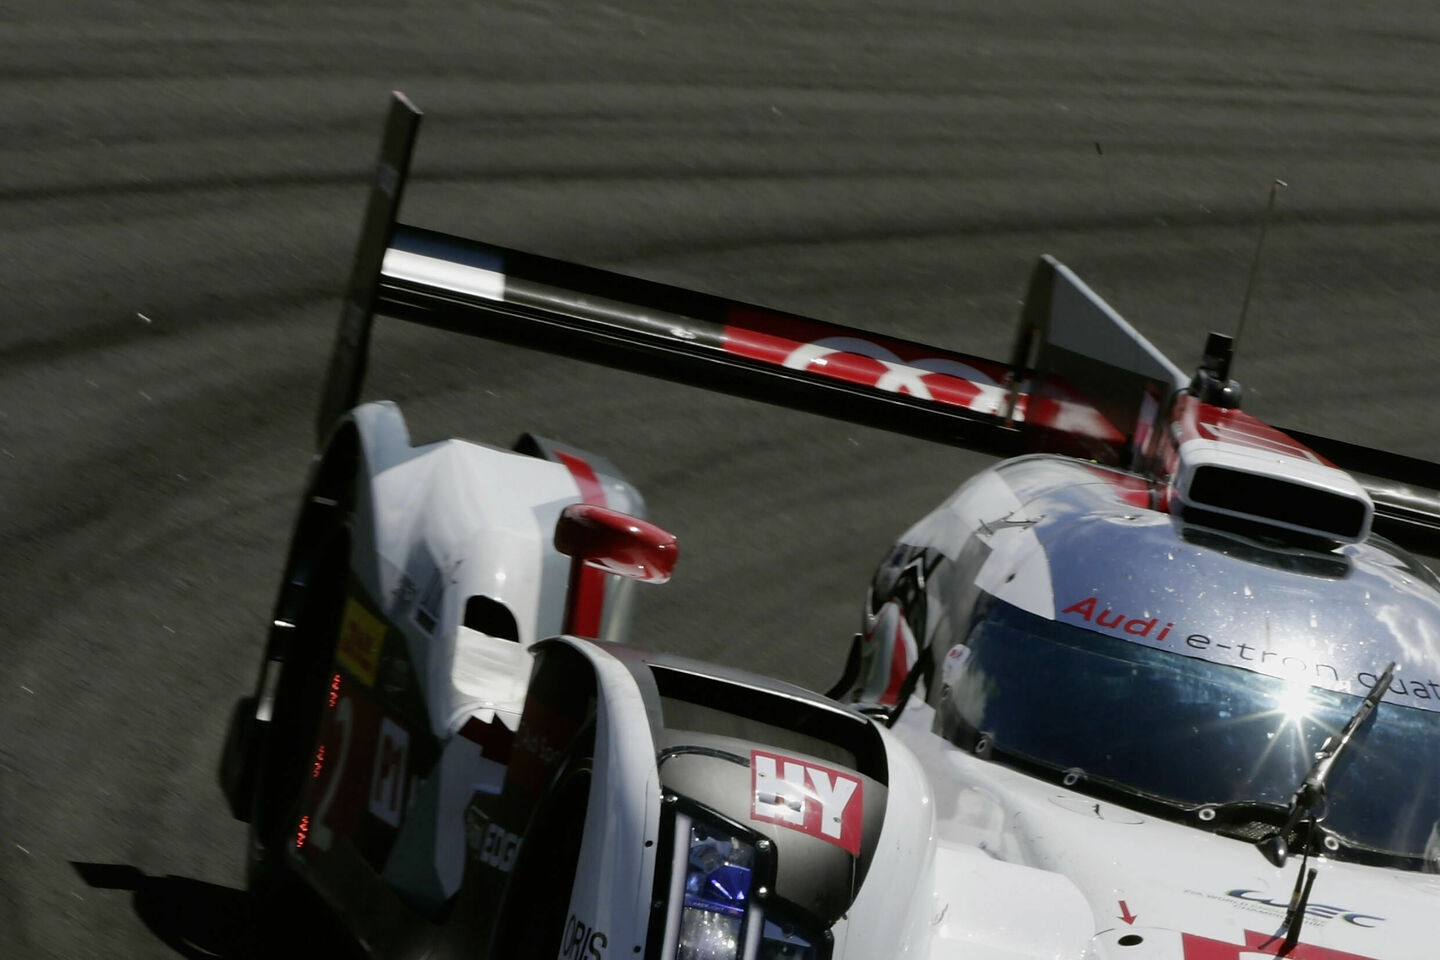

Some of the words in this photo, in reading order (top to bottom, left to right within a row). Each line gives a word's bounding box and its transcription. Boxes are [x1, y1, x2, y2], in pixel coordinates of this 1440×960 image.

[1062, 597, 1176, 642] Audi
[1185, 632, 1340, 682] e-tron
[755, 755, 858, 840] HY
